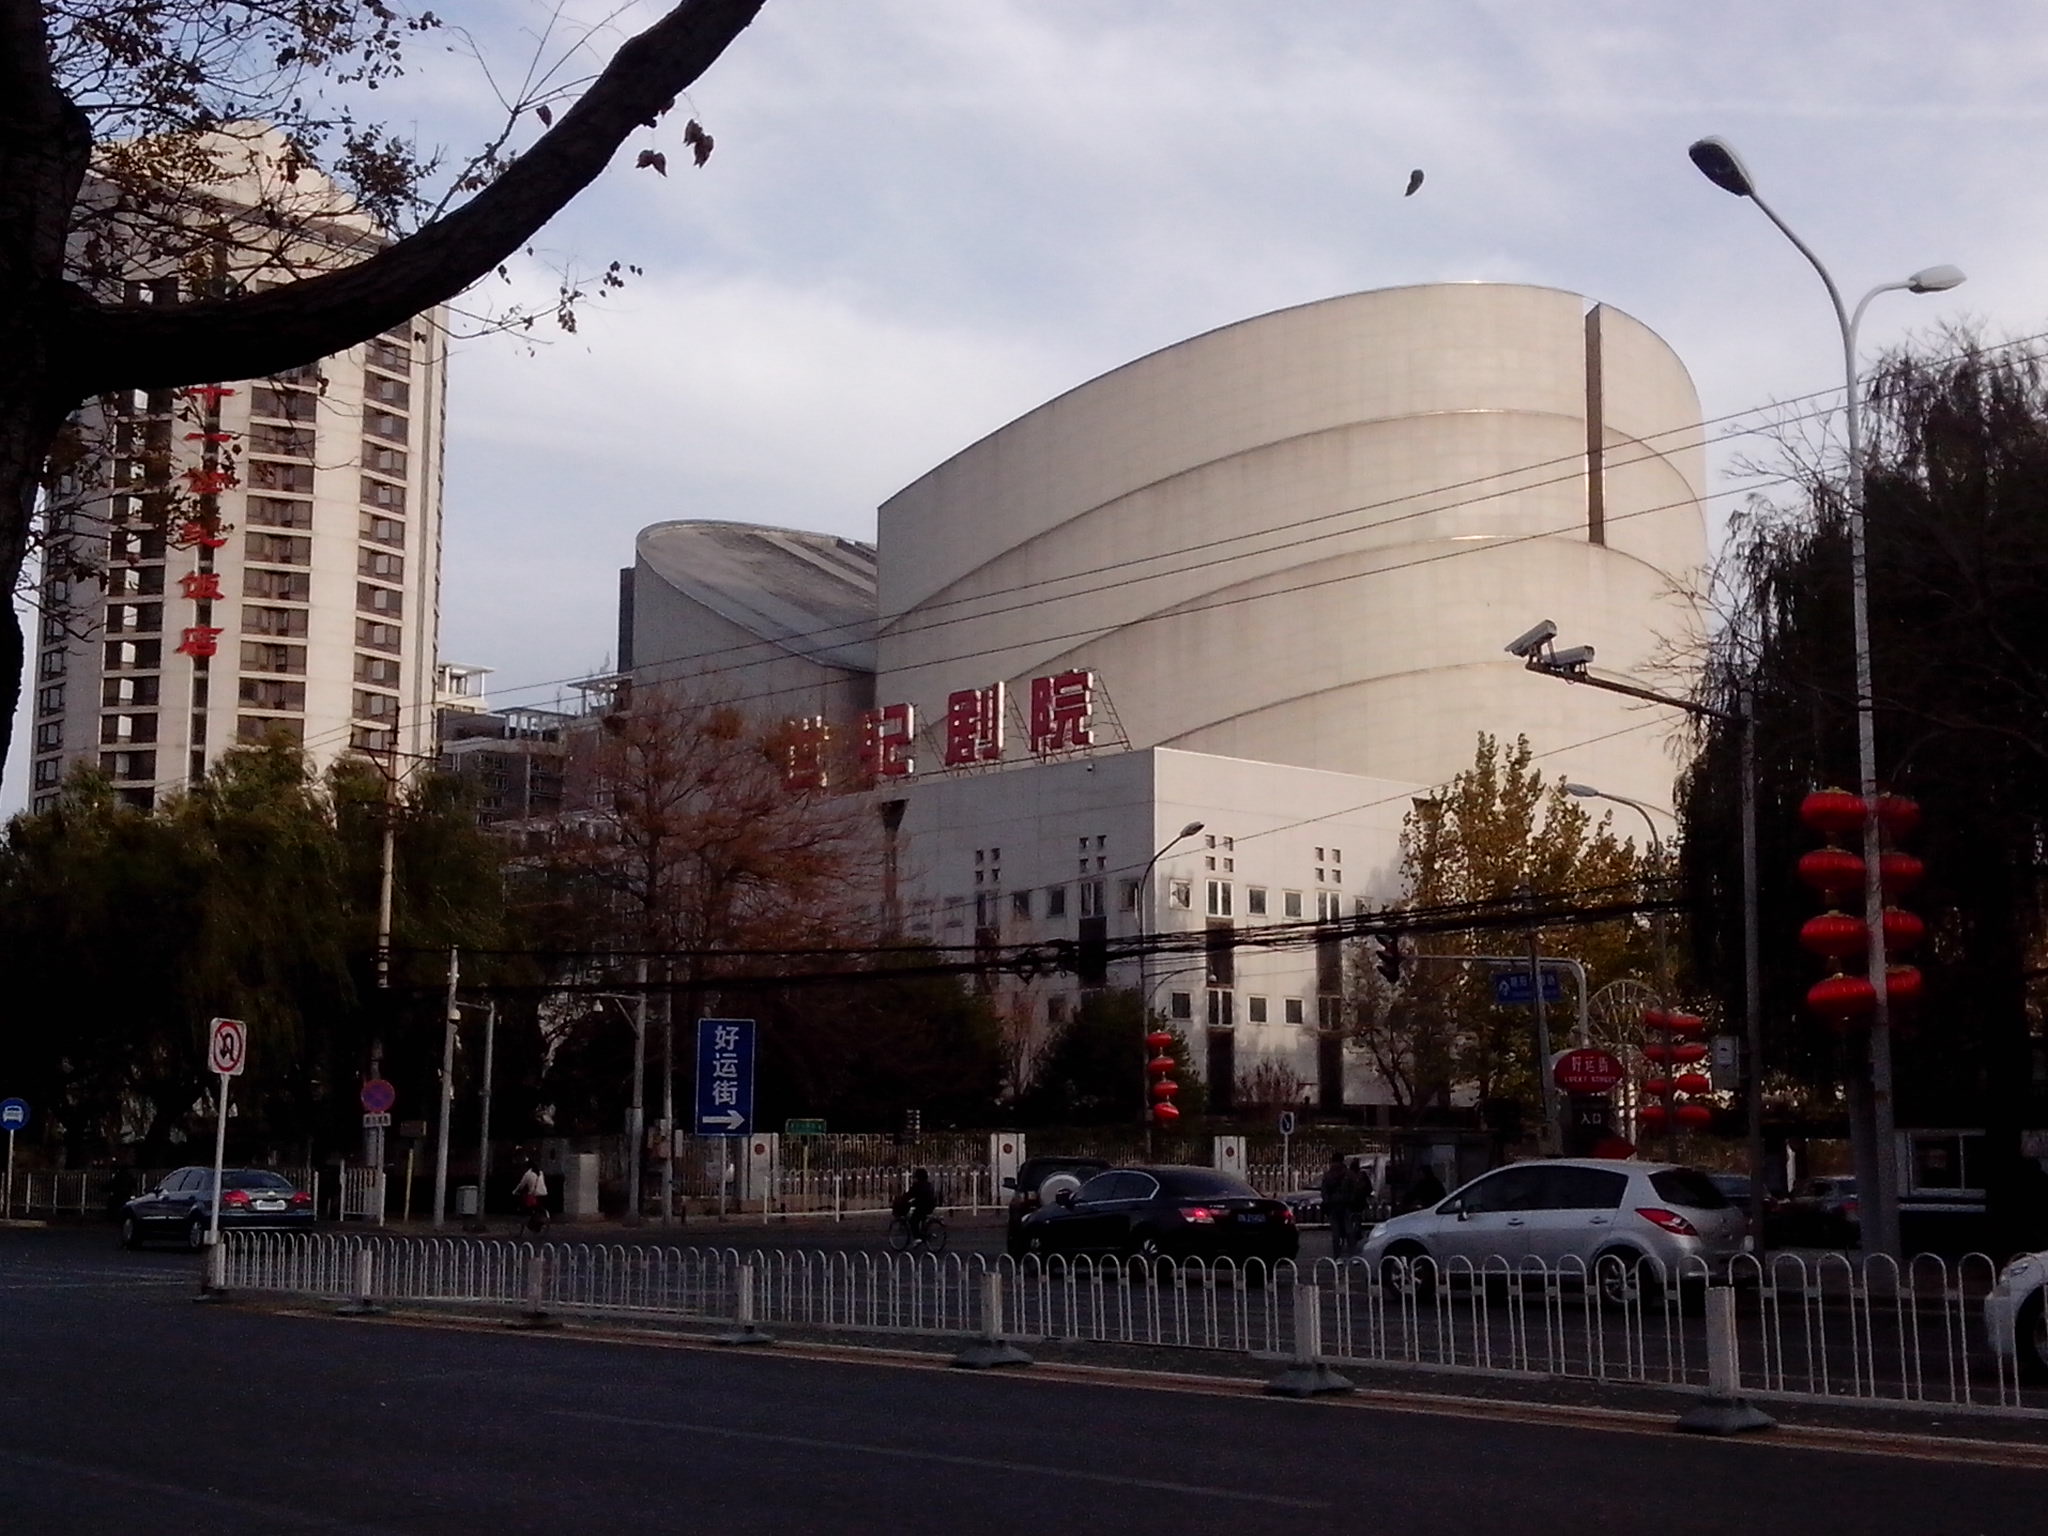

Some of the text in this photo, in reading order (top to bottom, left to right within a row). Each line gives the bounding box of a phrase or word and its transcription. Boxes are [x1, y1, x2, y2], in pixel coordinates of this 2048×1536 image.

[712, 1025, 739, 1106] 好运街
[1580, 1112, 1602, 1125] 入口
